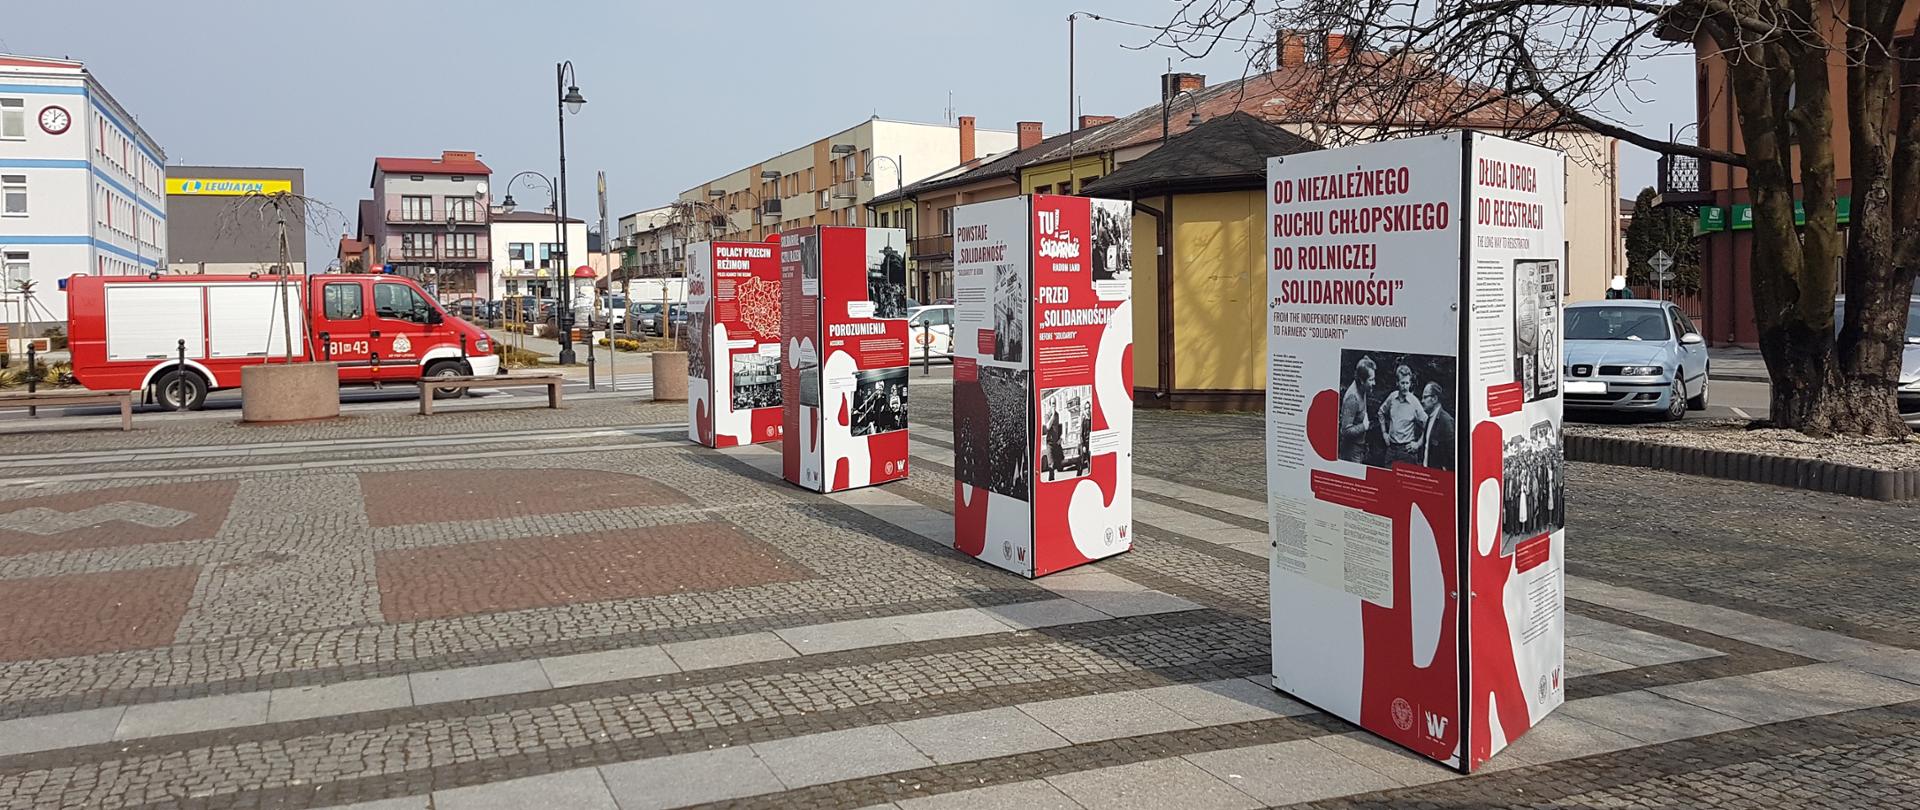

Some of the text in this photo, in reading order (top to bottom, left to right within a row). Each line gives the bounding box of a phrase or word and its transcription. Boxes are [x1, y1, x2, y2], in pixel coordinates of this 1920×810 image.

[1274, 165, 1409, 205] OD NIEZALEŻNEGO
[1479, 158, 1537, 194] DŁUGA DROGA
[205, 182, 264, 193] LEWIATAN
[1274, 202, 1449, 238] RUCHU CHŁOPSKIEGO
[1478, 197, 1544, 230] DO REJESTRACJI
[1038, 209, 1060, 238] TU!
[957, 224, 988, 243] POWSTAJE
[716, 247, 743, 257] POLACY
[1274, 244, 1377, 271] DO ROLNICZEJ
[716, 257, 750, 270] REŻIMOWI
[1039, 286, 1069, 304] PRZED
[1274, 272, 1404, 307] „SOLIDARNOŚCI”
[1273, 312, 1289, 323] FROM
[1289, 312, 1300, 324] THE
[1300, 312, 1339, 325] INDEPENDENT
[1371, 315, 1407, 328] MOVEMENT
[829, 322, 886, 337] POROZUMIENIA
[1273, 325, 1281, 336] TO
[353, 340, 369, 354] 43
